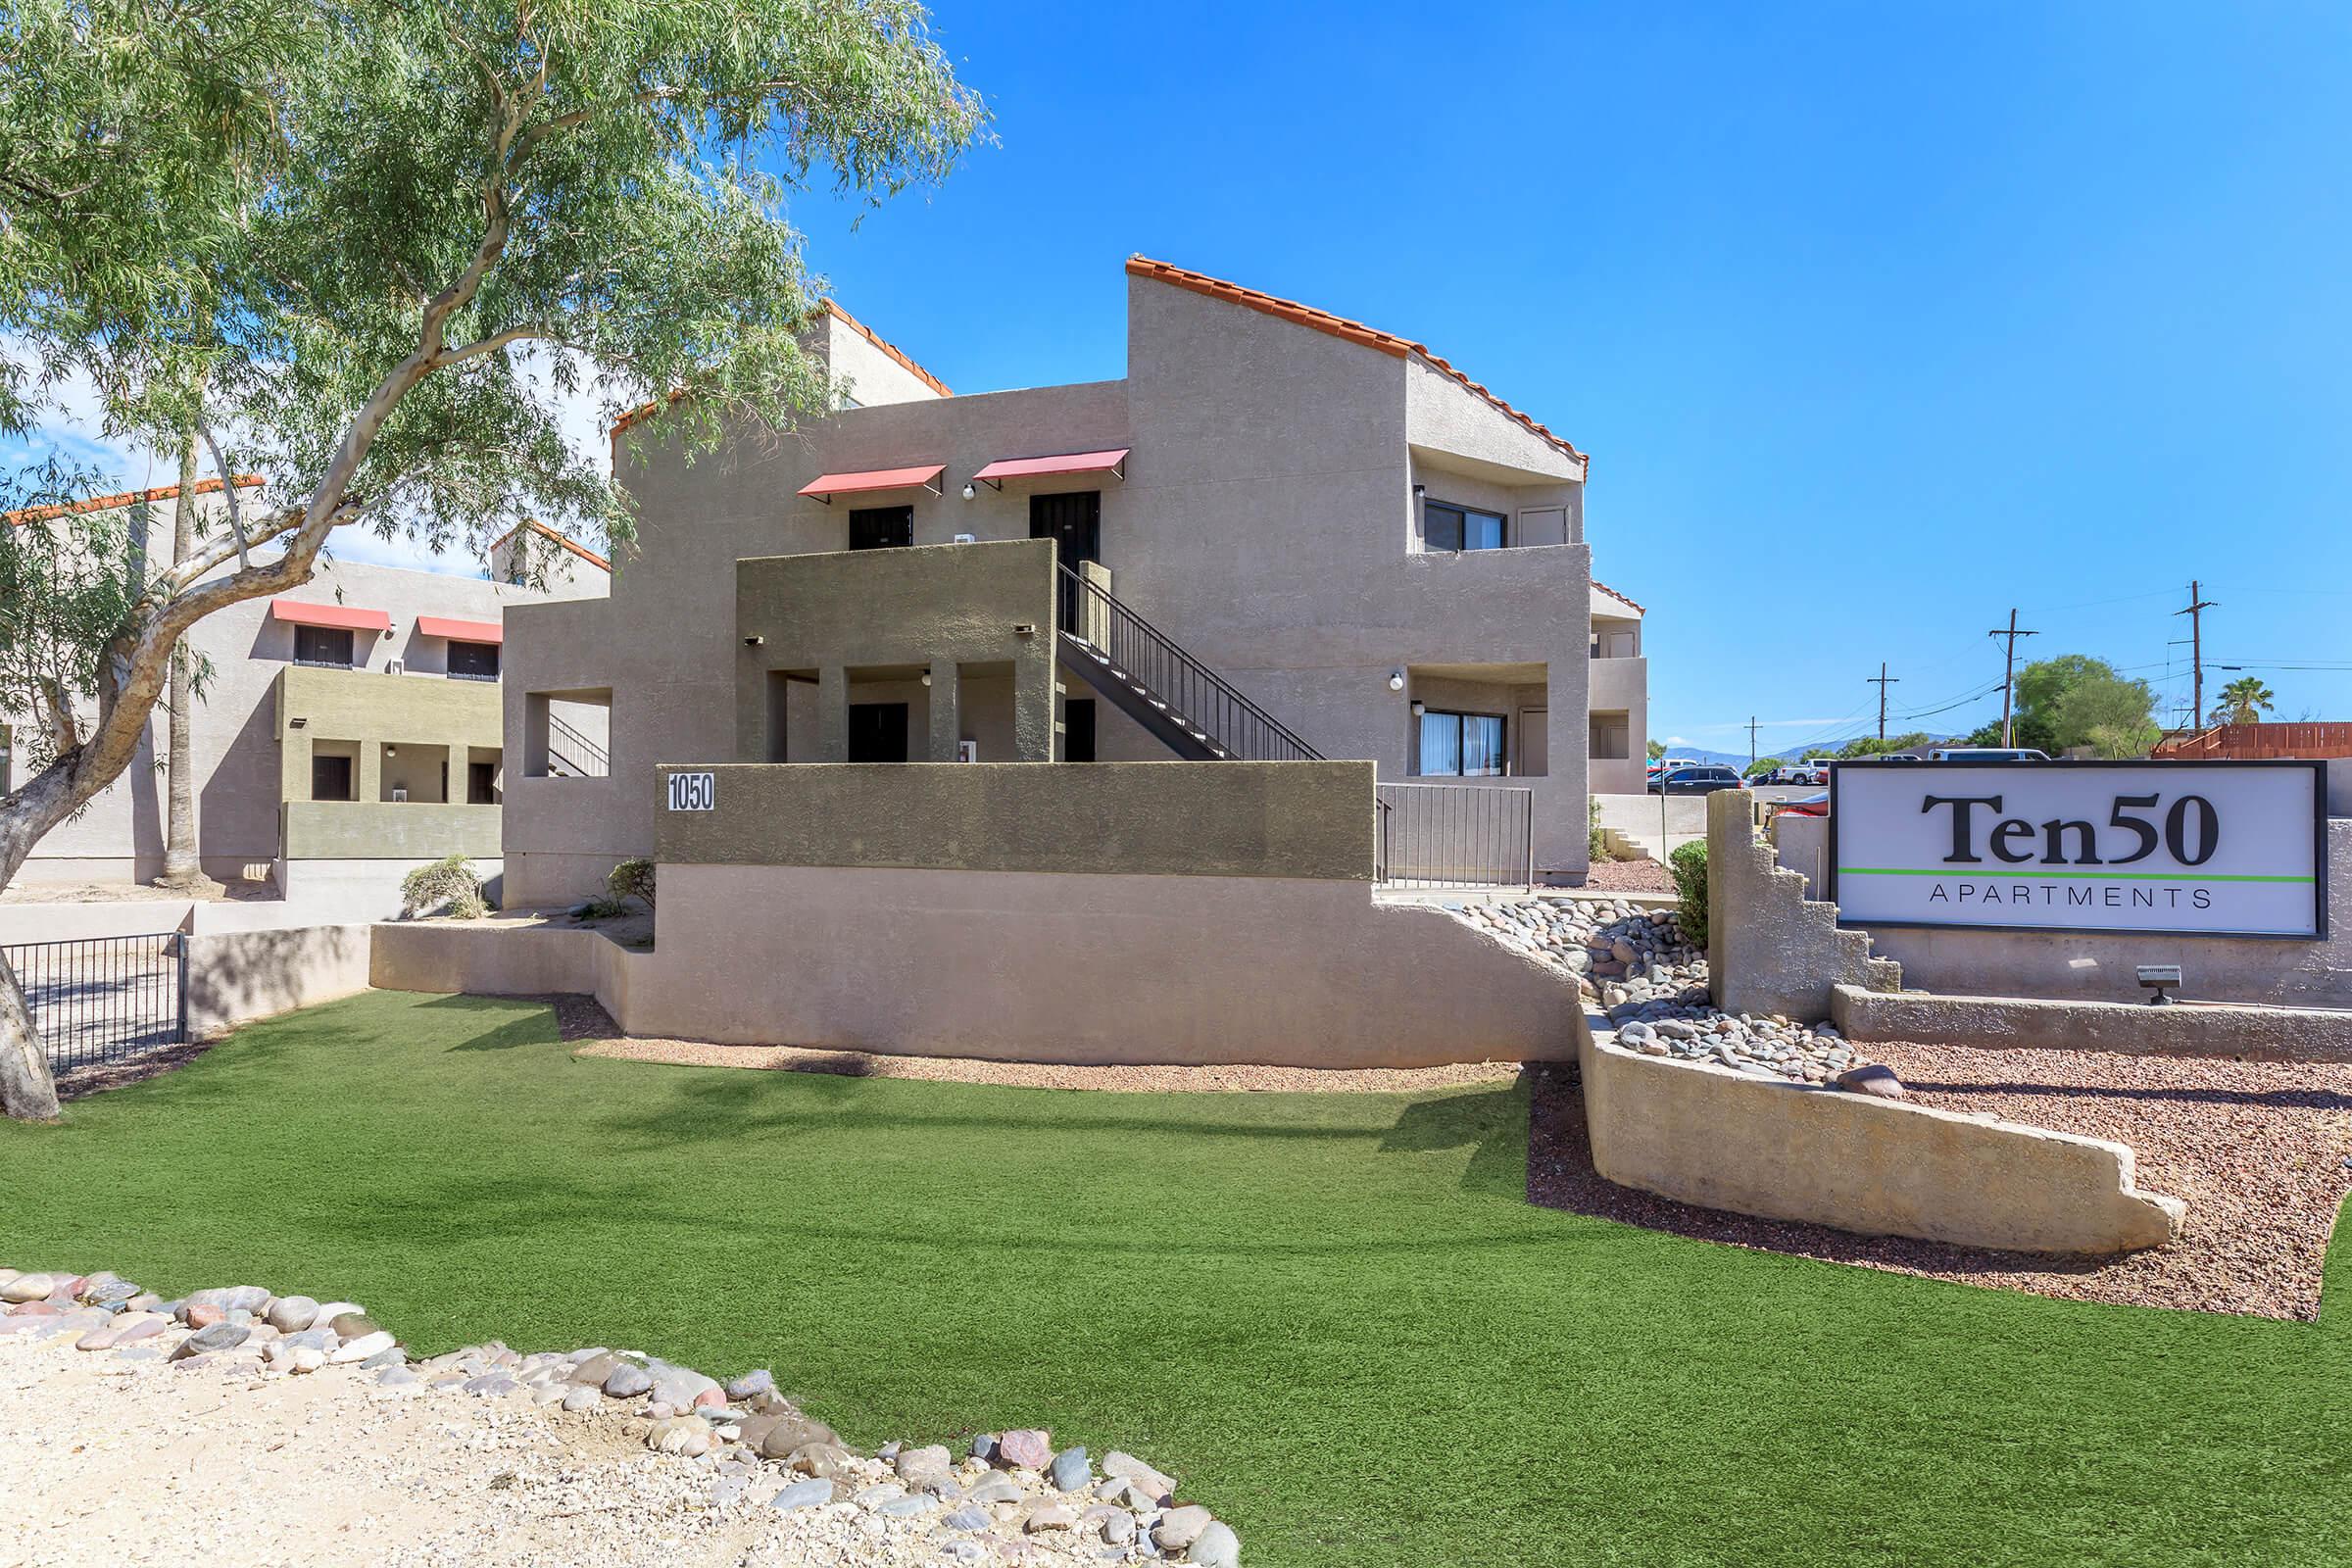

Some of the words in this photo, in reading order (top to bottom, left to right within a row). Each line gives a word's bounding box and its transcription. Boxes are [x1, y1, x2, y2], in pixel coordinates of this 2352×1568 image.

[670, 774, 712, 809] 1050
[1921, 793, 2220, 866] Ten50
[1929, 883, 2211, 909] APARTMENTS
